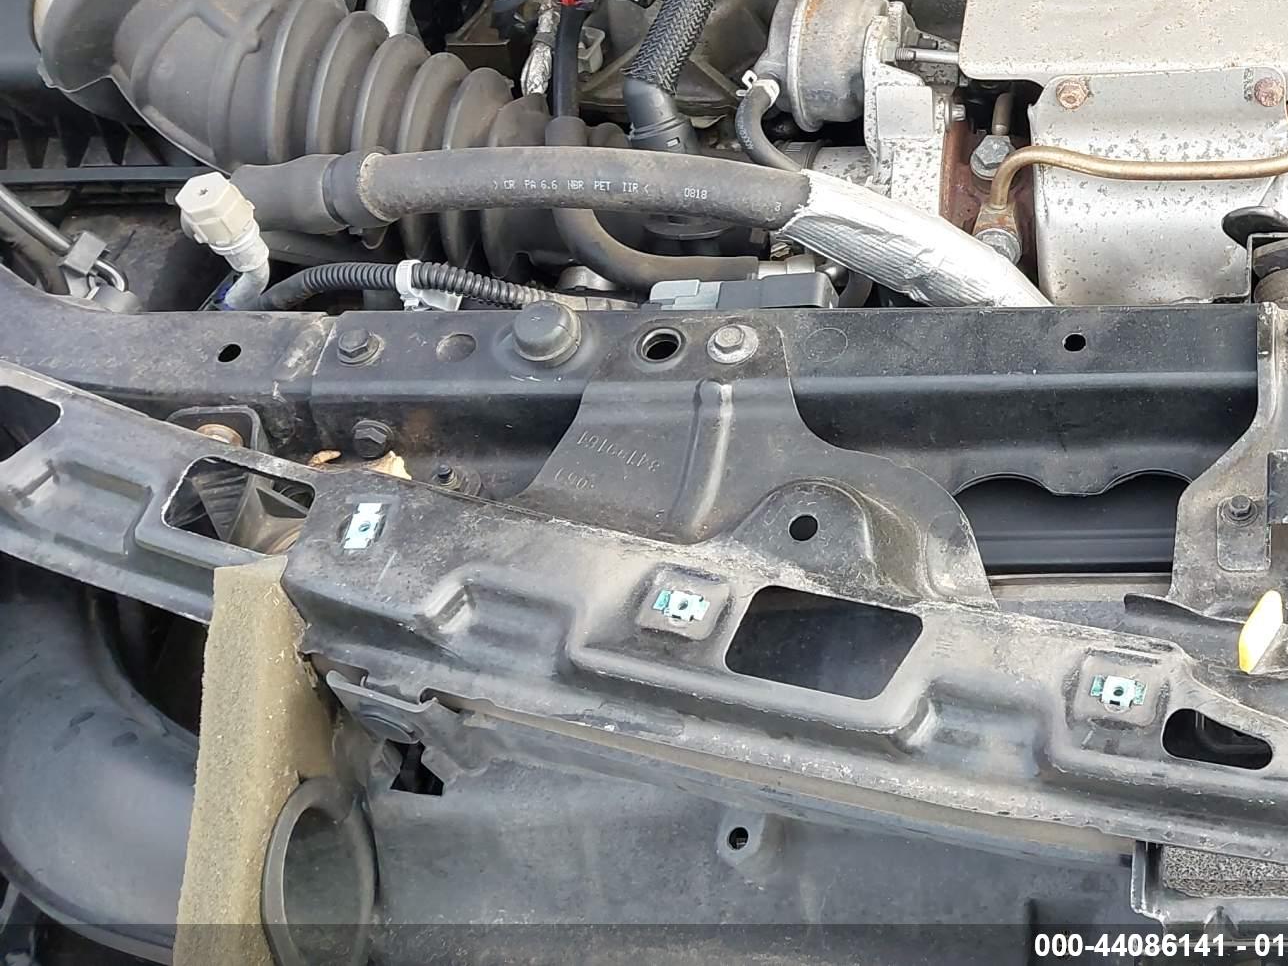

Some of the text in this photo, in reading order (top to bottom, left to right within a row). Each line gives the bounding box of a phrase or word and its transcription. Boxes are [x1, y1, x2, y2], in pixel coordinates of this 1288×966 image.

[503, 180, 515, 189] CR
[593, 180, 611, 191] PET
[684, 187, 708, 199] 0818
